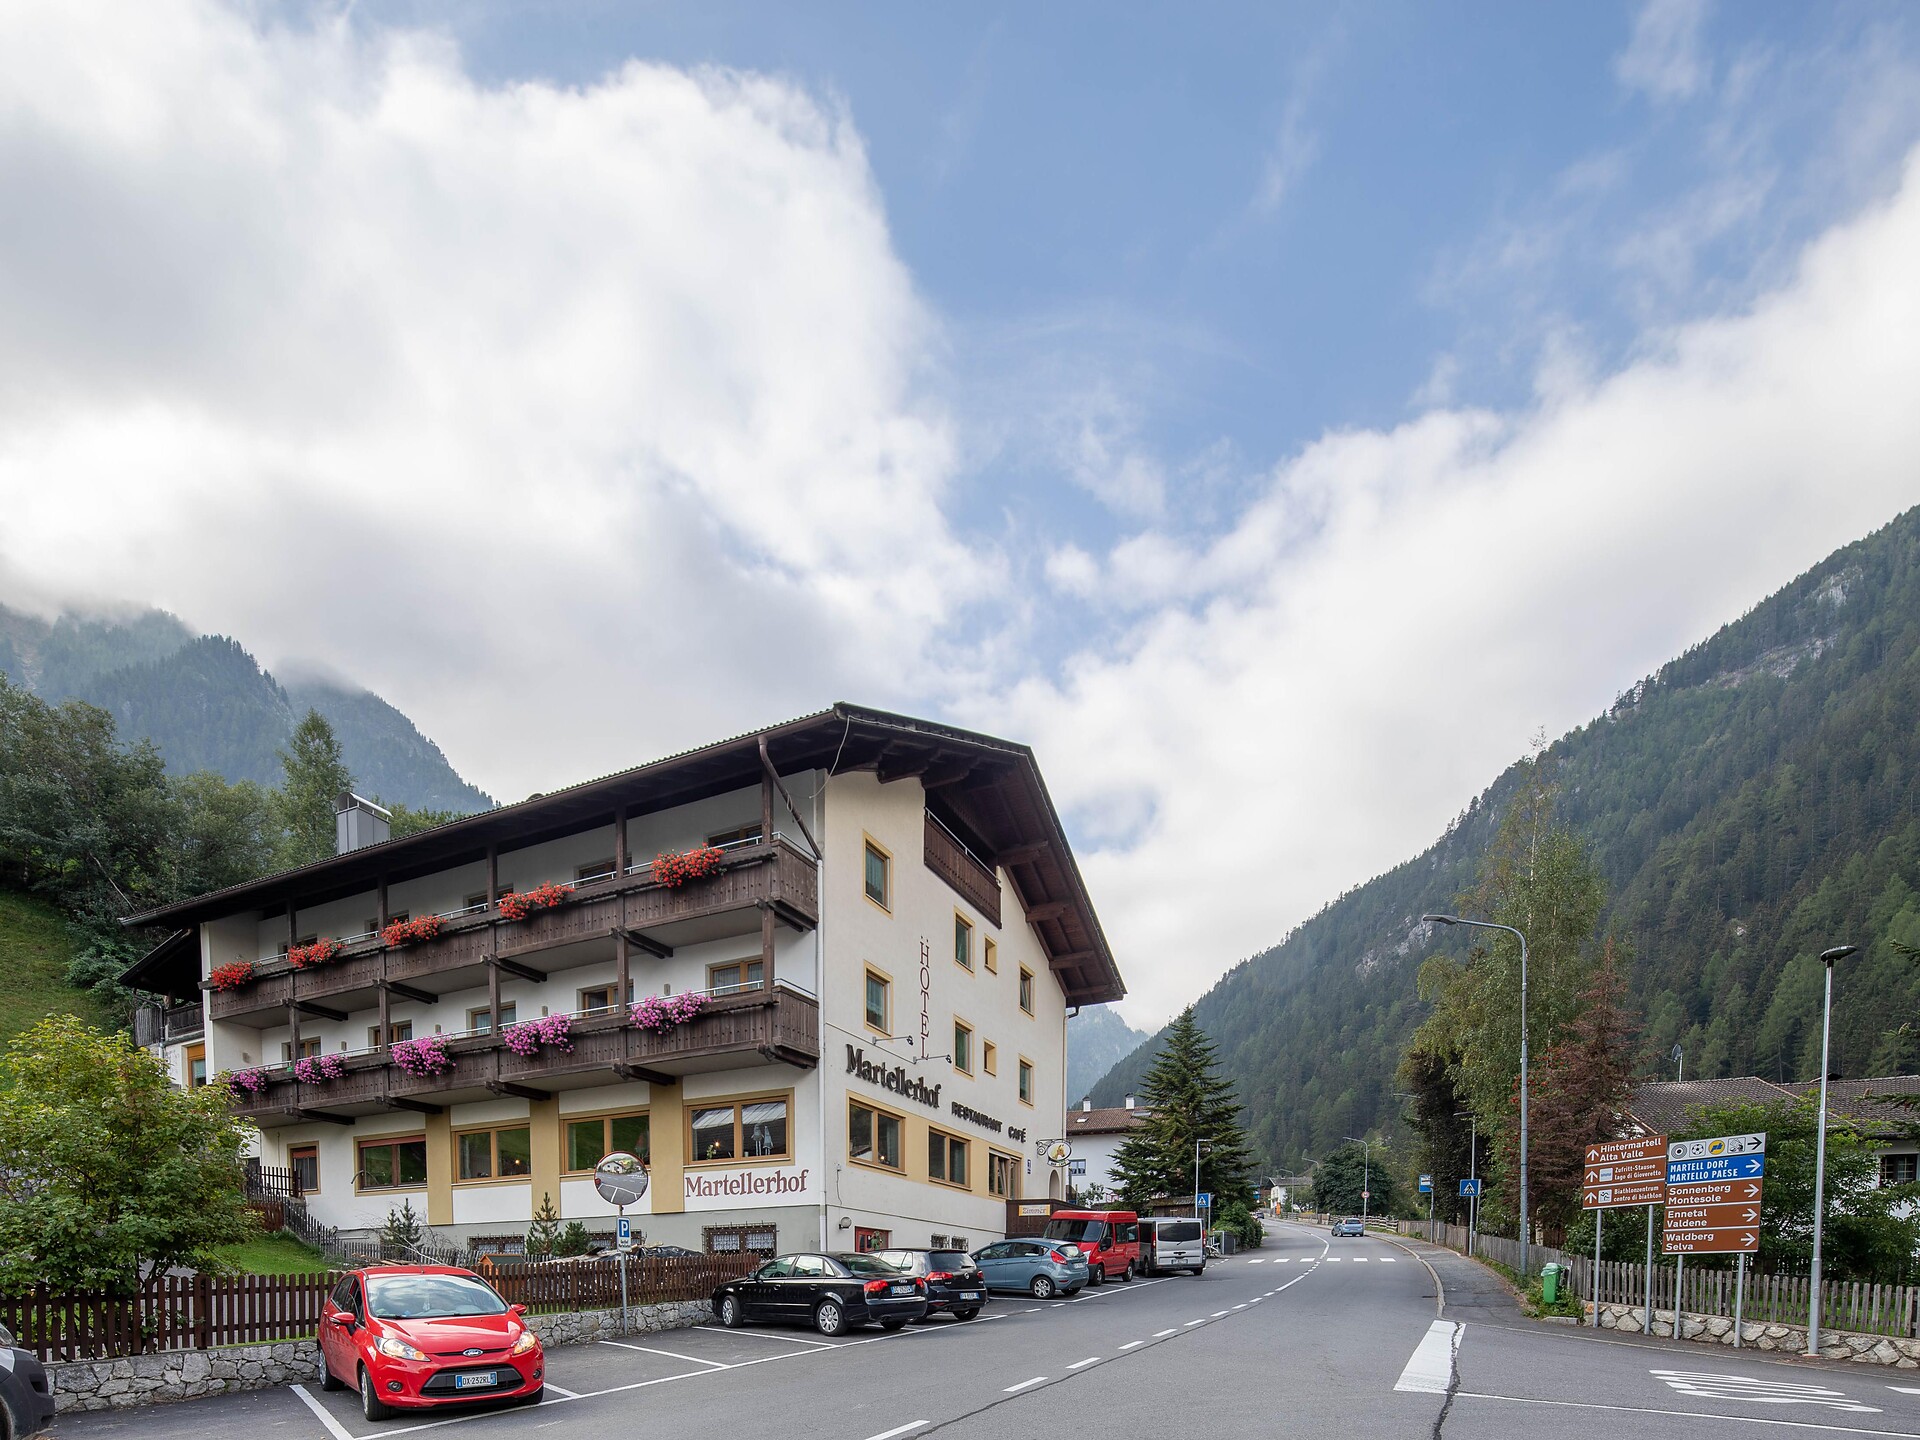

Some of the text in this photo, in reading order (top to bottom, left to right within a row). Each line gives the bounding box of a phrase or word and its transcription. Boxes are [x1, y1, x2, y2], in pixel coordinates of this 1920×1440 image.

[919, 940, 930, 1060] HOTEL
[845, 1043, 942, 1109] Martellerhof
[951, 1101, 1027, 1143] RESTAURANT CAFÉ
[1600, 1138, 1662, 1153] Hintermartell
[1599, 1150, 1644, 1162] Alta Valle
[1670, 1159, 1729, 1173] MARTELL DORF
[1669, 1168, 1738, 1182] MARTELLO PAESE
[685, 1169, 809, 1198] Martellerhof
[1668, 1184, 1731, 1196] Sonnenberg
[1668, 1194, 1722, 1205] Montesole
[1667, 1209, 1707, 1219] Ennetal
[621, 1220, 629, 1236] P
[1667, 1218, 1708, 1228] Valdene
[1665, 1232, 1714, 1242] Waldberg
[1665, 1242, 1694, 1251] Selva
